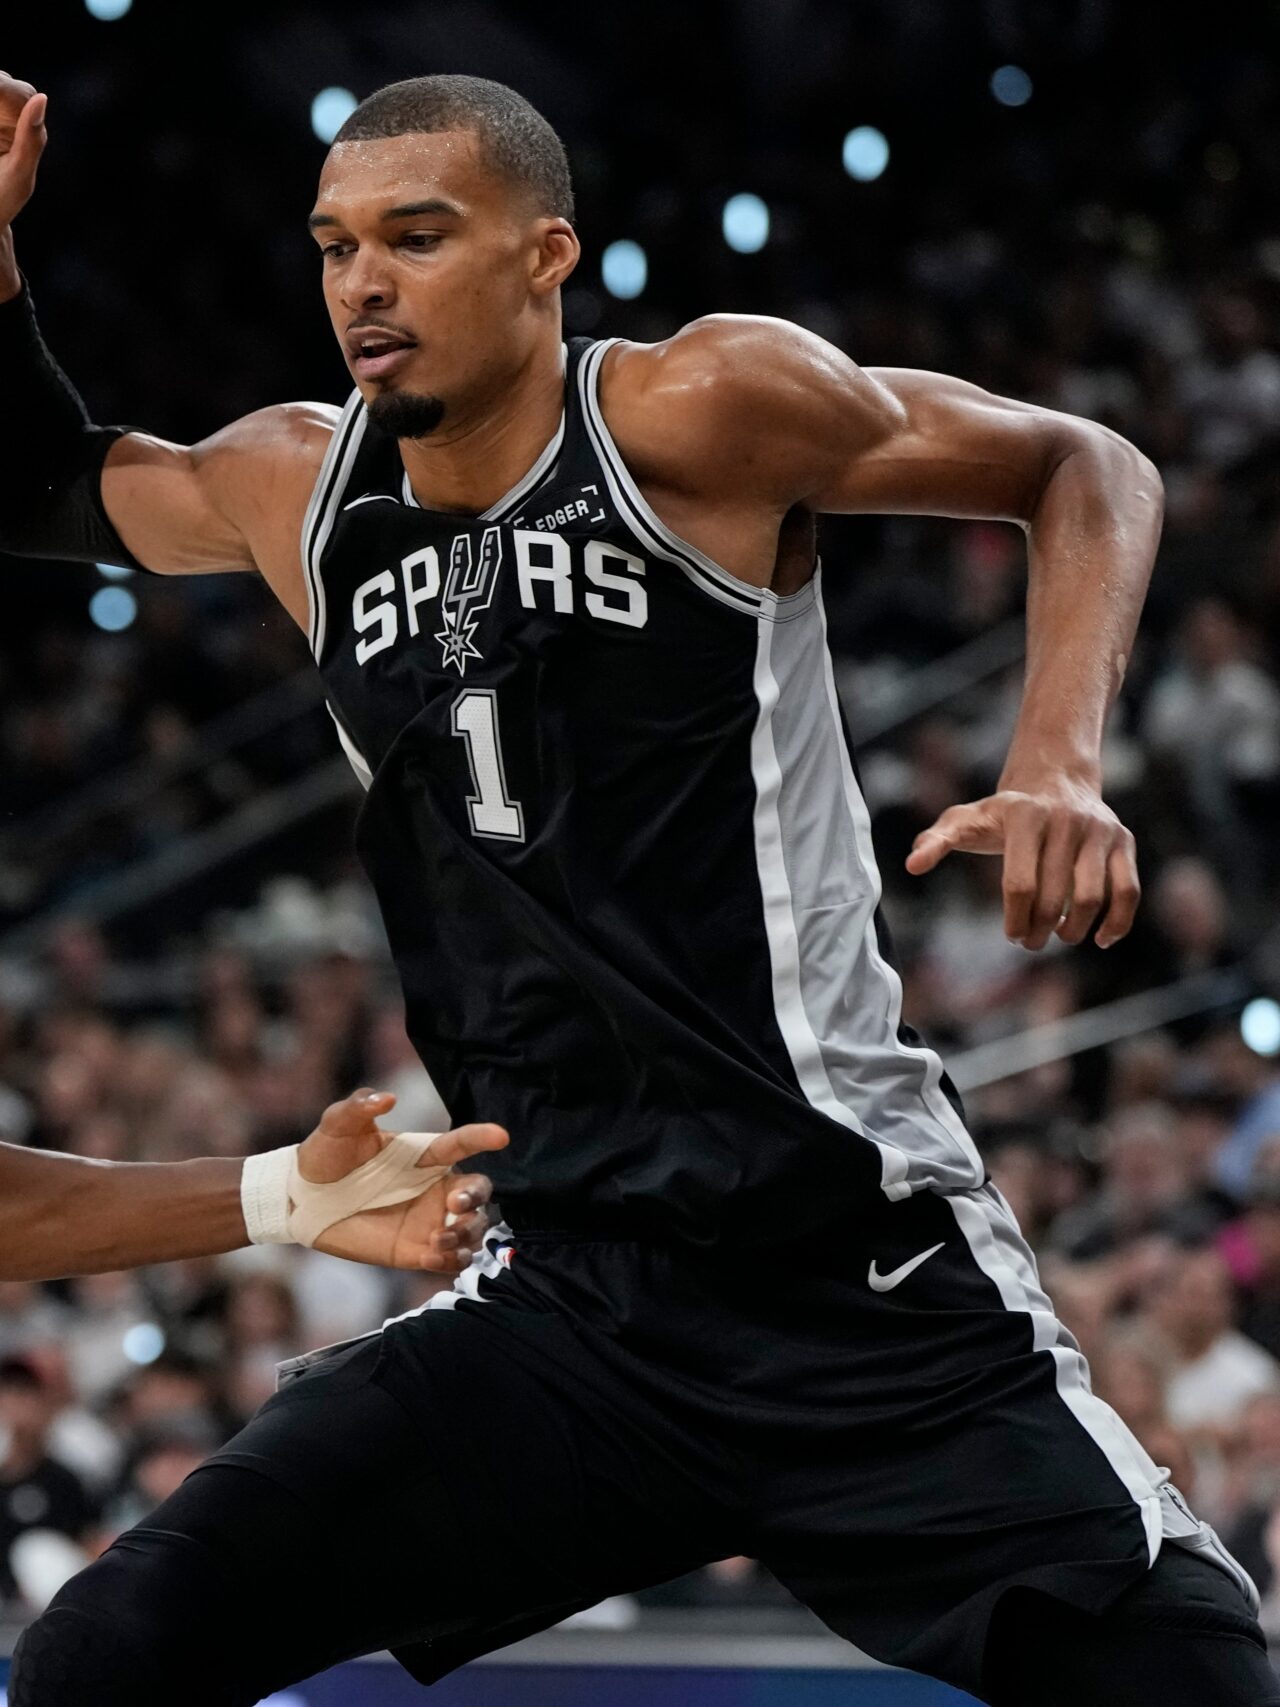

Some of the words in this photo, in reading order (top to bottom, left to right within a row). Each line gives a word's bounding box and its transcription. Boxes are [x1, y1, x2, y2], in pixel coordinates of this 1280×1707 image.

[526, 499, 589, 531] EDGER
[352, 526, 648, 677] SPURS
[451, 688, 525, 843] 1
